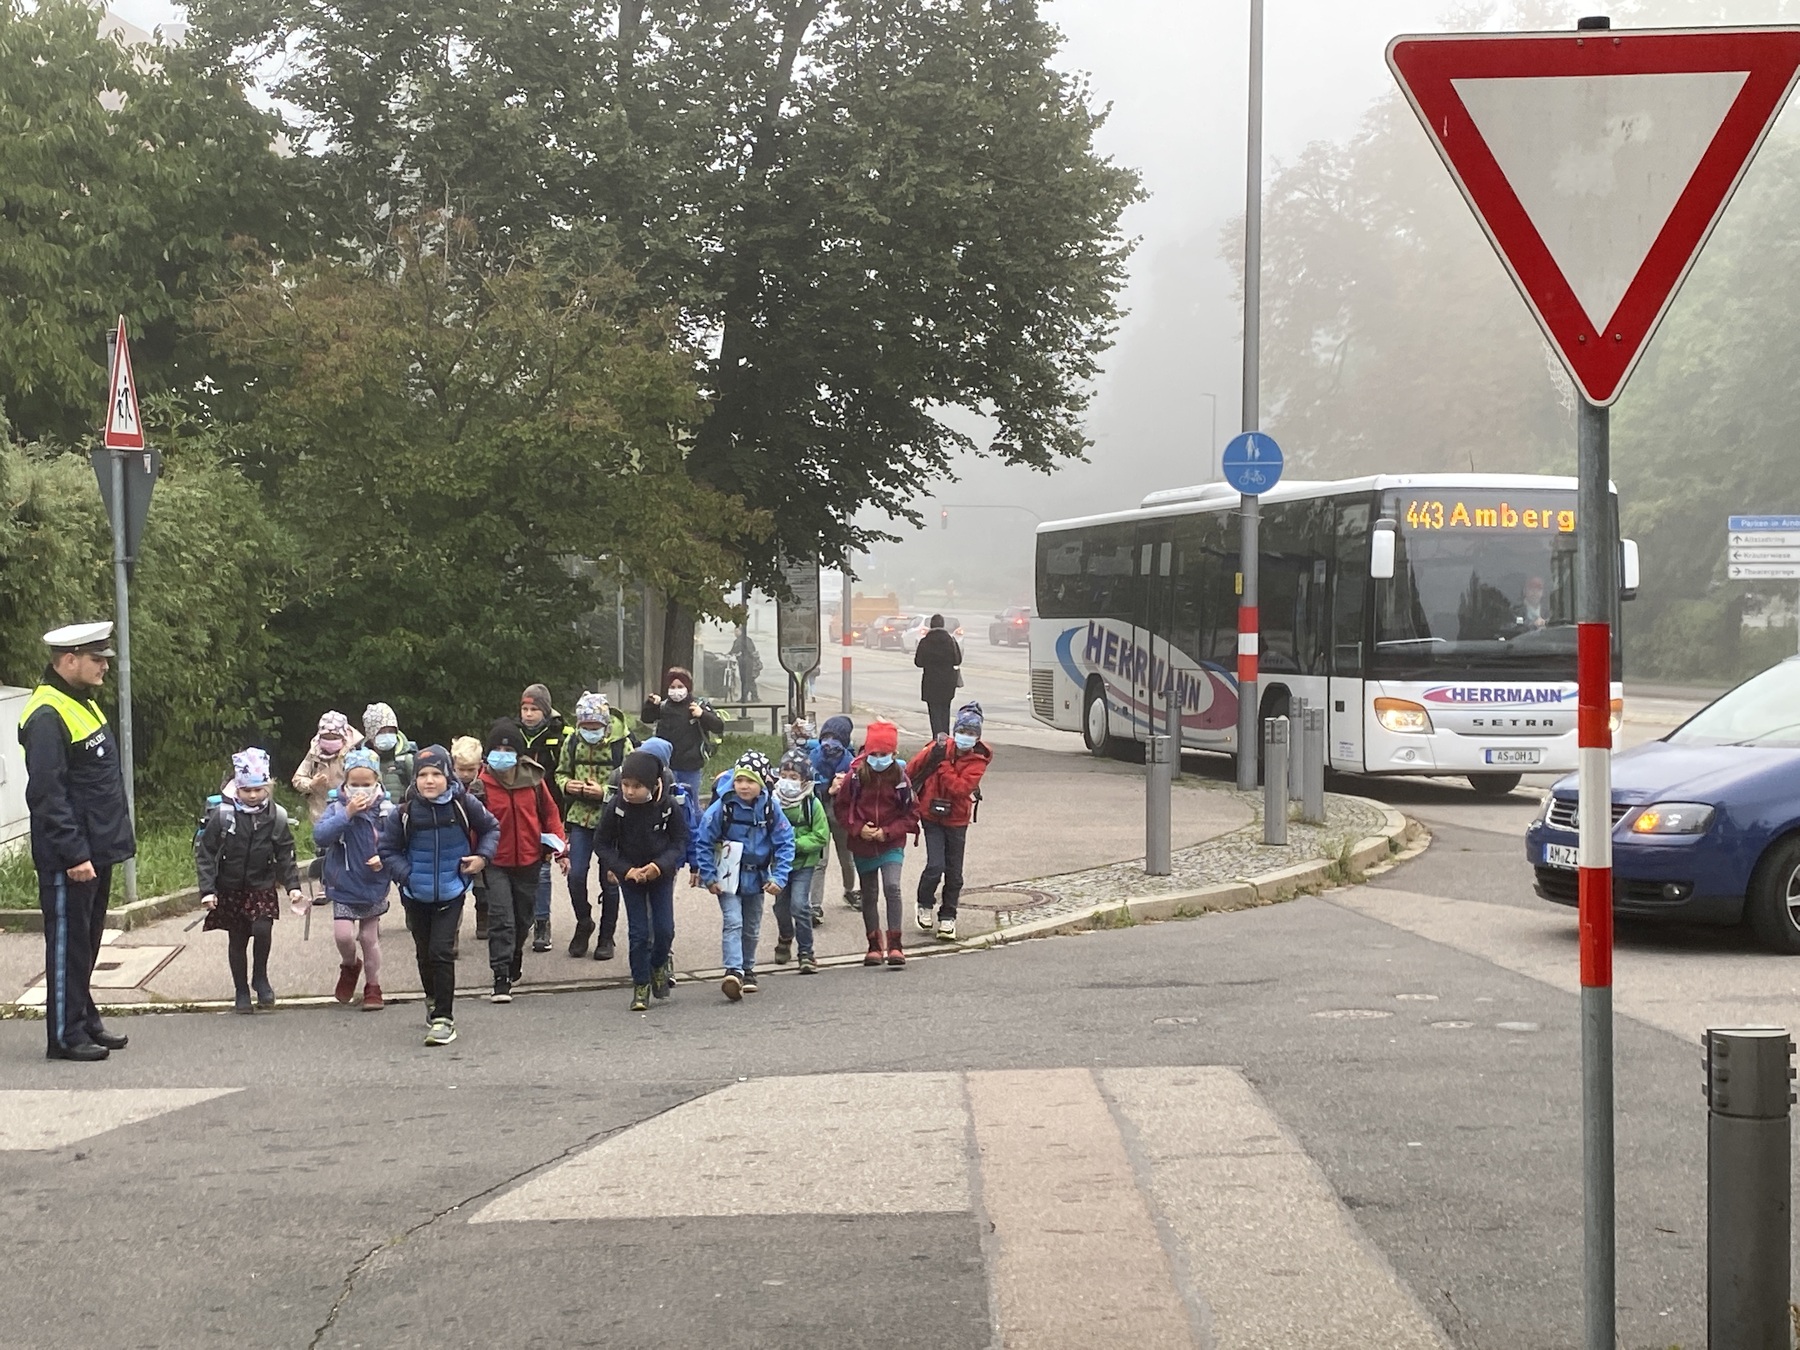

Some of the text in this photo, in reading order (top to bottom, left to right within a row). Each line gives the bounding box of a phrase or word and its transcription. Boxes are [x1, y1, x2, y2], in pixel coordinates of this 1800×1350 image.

[1406, 500, 1577, 533] 443 Amberg
[1085, 619, 1202, 713] HERRMANN
[1451, 687, 1562, 703] HERRMANN
[1472, 718, 1554, 727] SETRA
